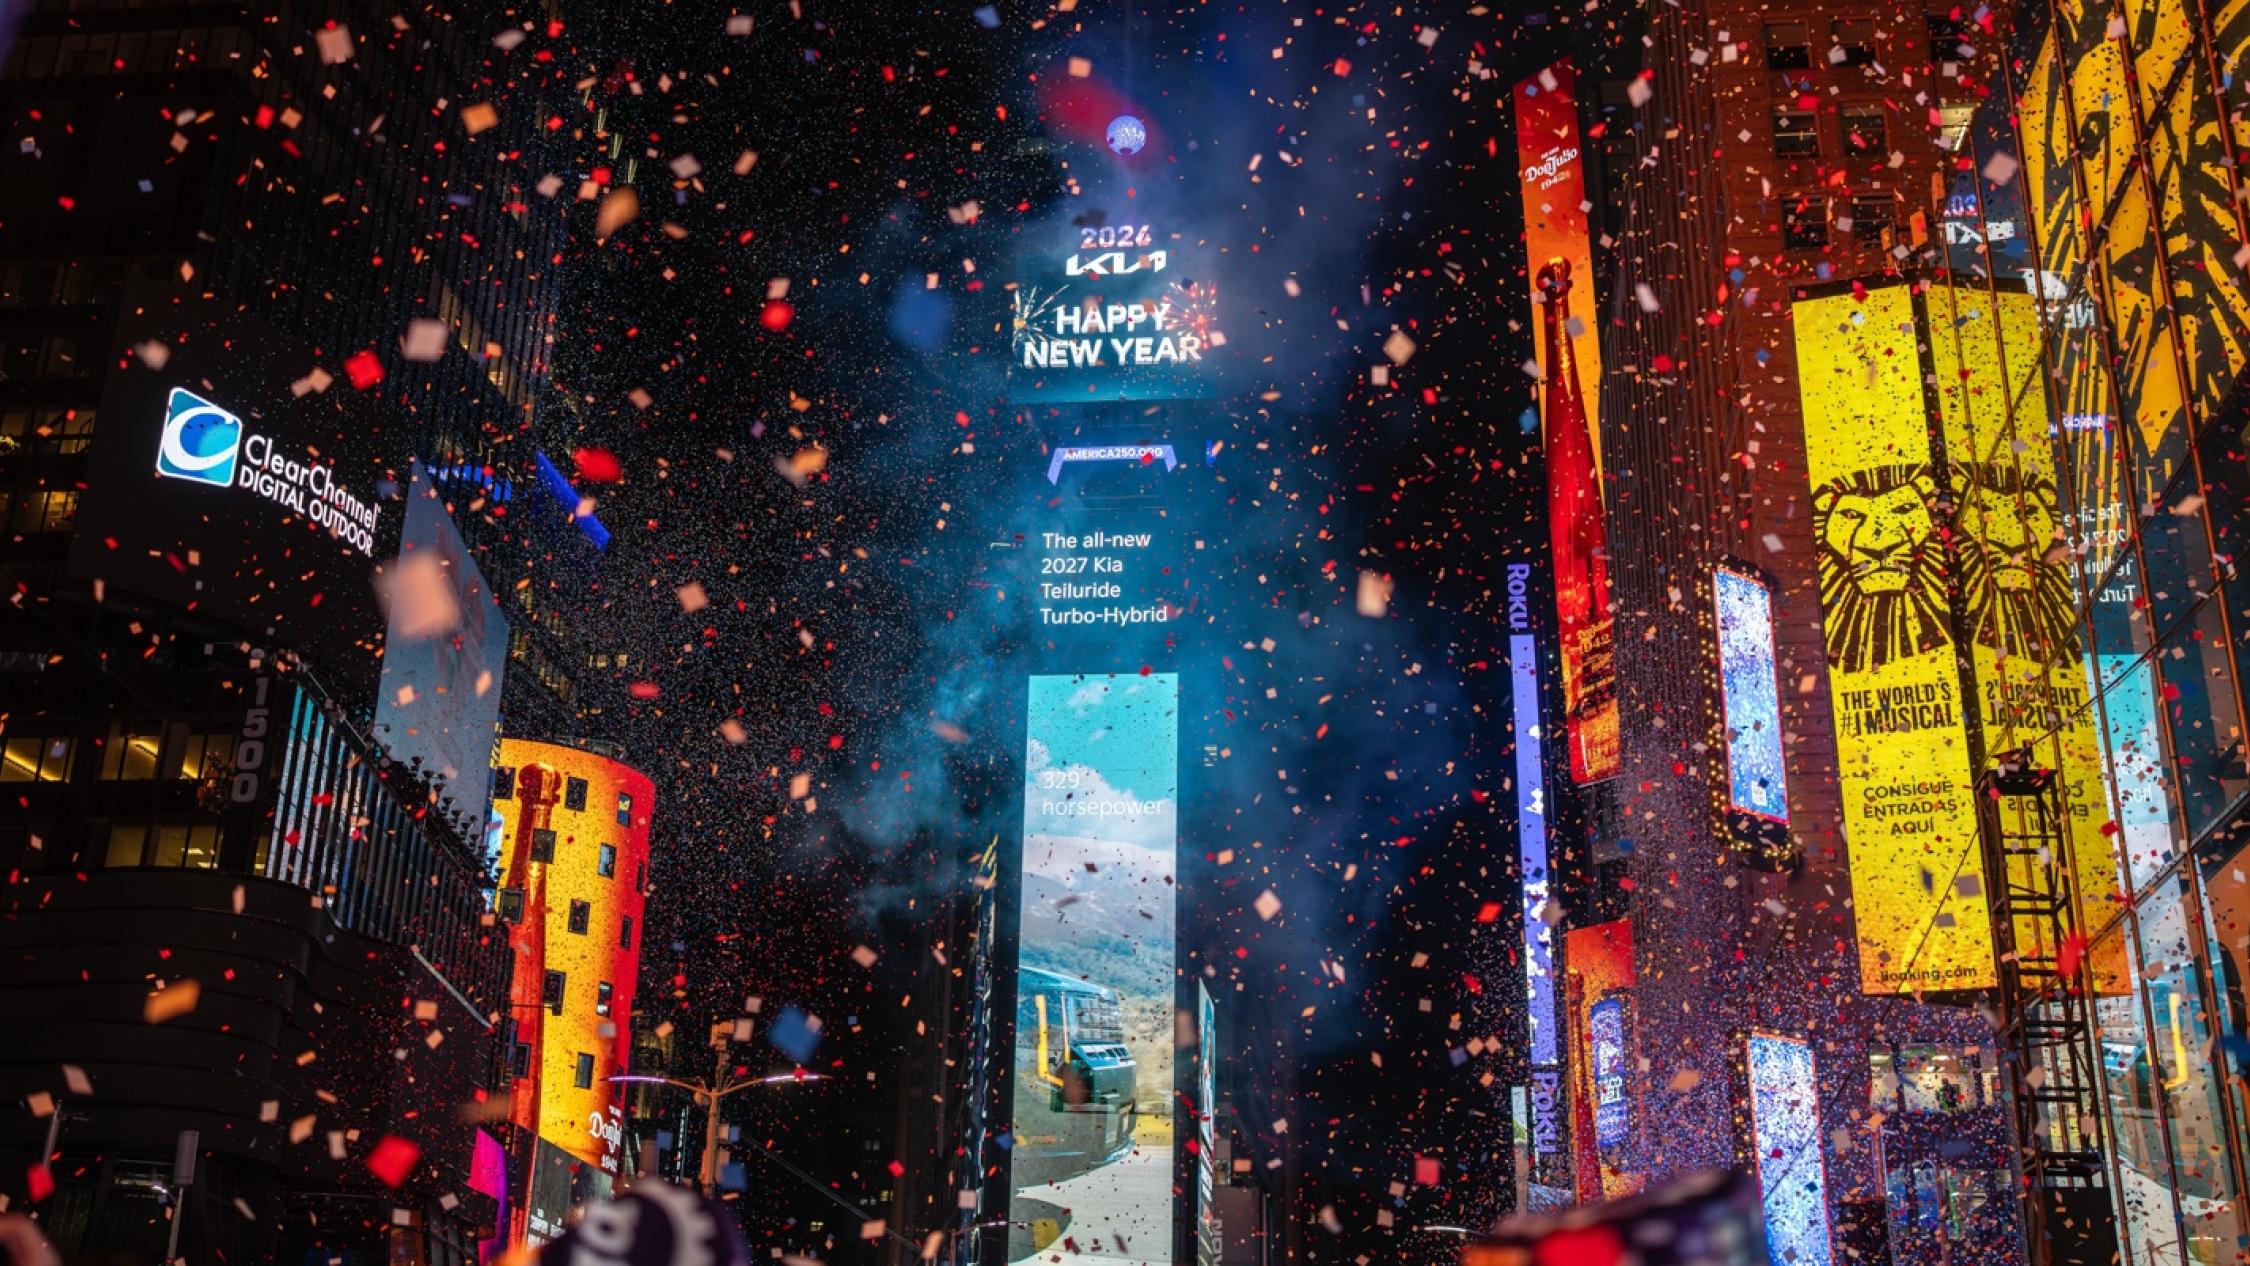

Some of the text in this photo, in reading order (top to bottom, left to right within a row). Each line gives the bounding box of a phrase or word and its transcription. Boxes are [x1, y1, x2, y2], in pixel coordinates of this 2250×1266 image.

[1080, 224, 1152, 249] 2026
[1066, 250, 1167, 276] KIA
[1056, 302, 1171, 335] HAPPY
[1023, 335, 1202, 369] NEW YEAR
[245, 434, 381, 533] ClearChannel
[239, 465, 374, 558] DIGITAL OUTDOOR
[1043, 531, 1151, 549] The all-new
[1041, 556, 1123, 574] 2027 Kia
[1040, 606, 1168, 627] Turbo-Hybrid
[1841, 682, 1952, 711] THE WORLD'S
[1864, 703, 1957, 734] MUSICAL
[231, 676, 270, 803] 1500
[1043, 770, 1080, 789] 329
[1863, 780, 1954, 800] CONSIGUE
[1863, 799, 1958, 819] ENTRADAS
[1891, 816, 1935, 835] AQUÍ
